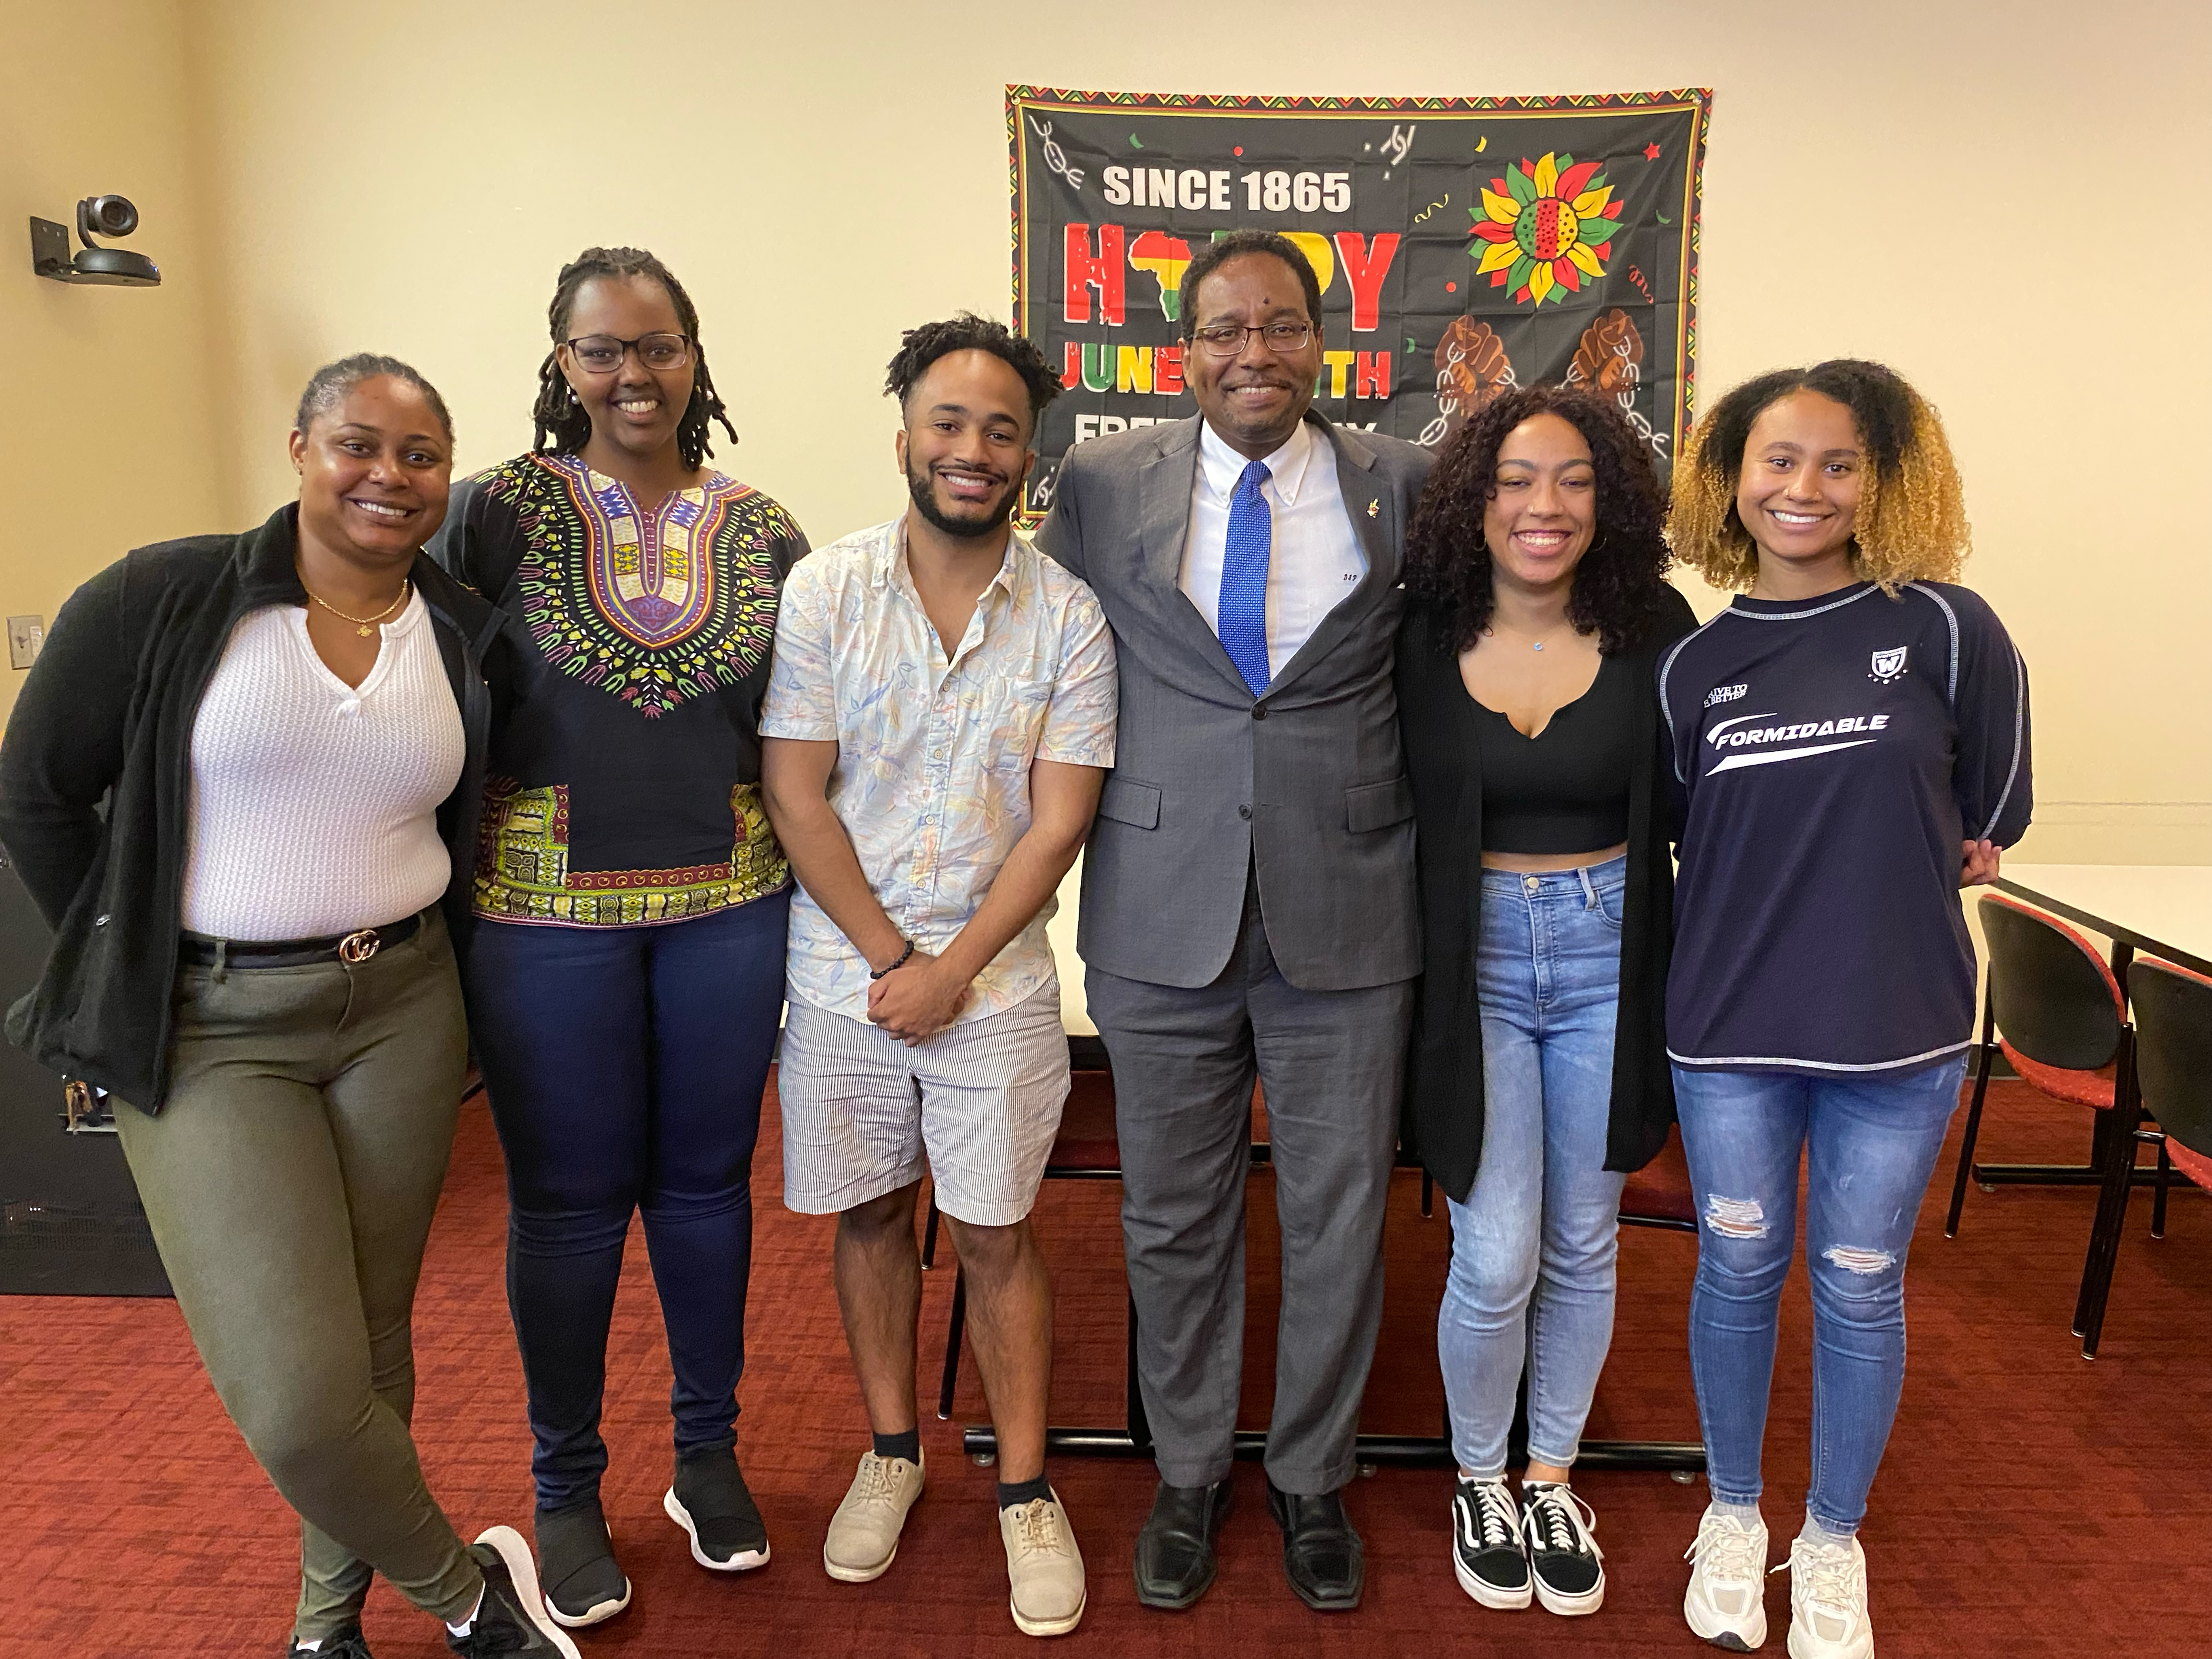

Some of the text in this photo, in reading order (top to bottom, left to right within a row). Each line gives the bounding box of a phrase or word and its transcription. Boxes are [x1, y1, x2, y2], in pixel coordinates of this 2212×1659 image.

[1103, 166, 1351, 213] SINCE 1865
[1059, 341, 1391, 400] JUNETH
[1732, 684, 1748, 694] TO
[1715, 715, 1890, 750] FORMIDABLE
